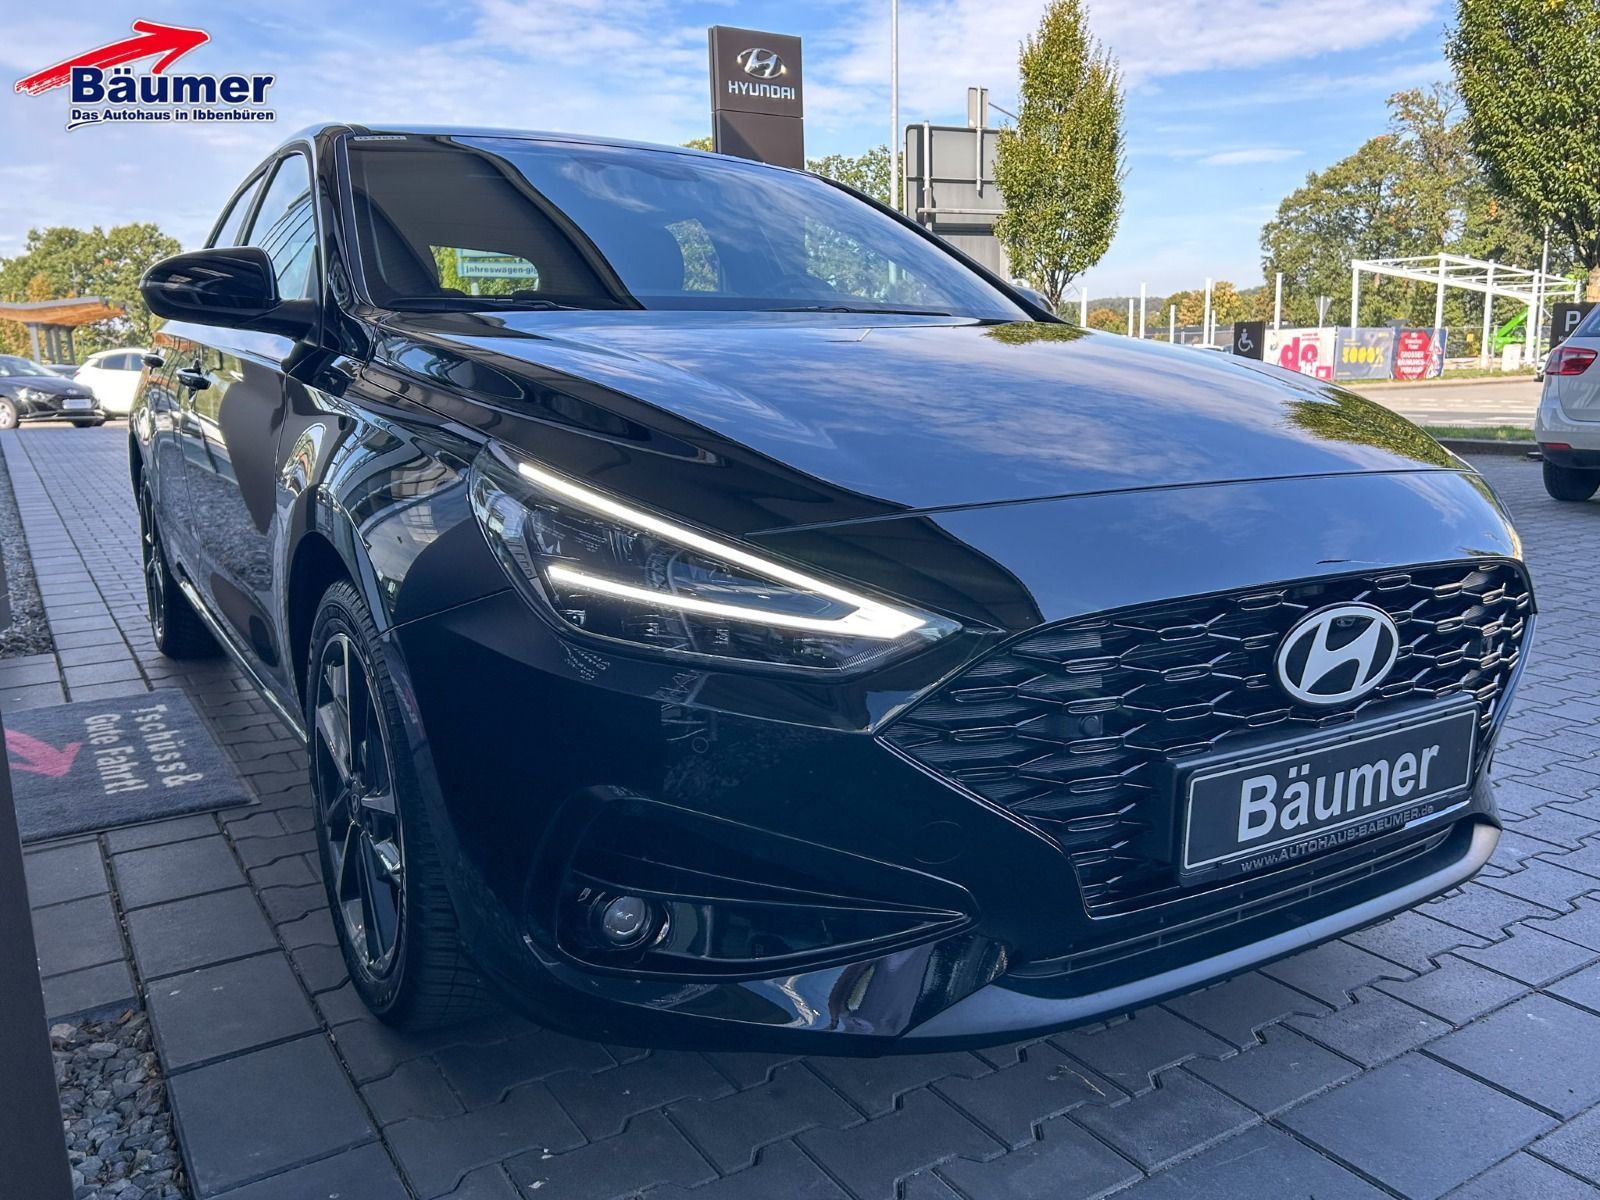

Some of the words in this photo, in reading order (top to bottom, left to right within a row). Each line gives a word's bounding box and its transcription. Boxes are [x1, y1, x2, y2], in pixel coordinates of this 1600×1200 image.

[728, 80, 795, 100] HYUNDAI
[1565, 310, 1581, 332] P
[84, 713, 125, 745] Gute
[1237, 744, 1440, 842] Bäumer
[1240, 804, 1434, 872] www.AUTOHAUS-BAEUMER.de
